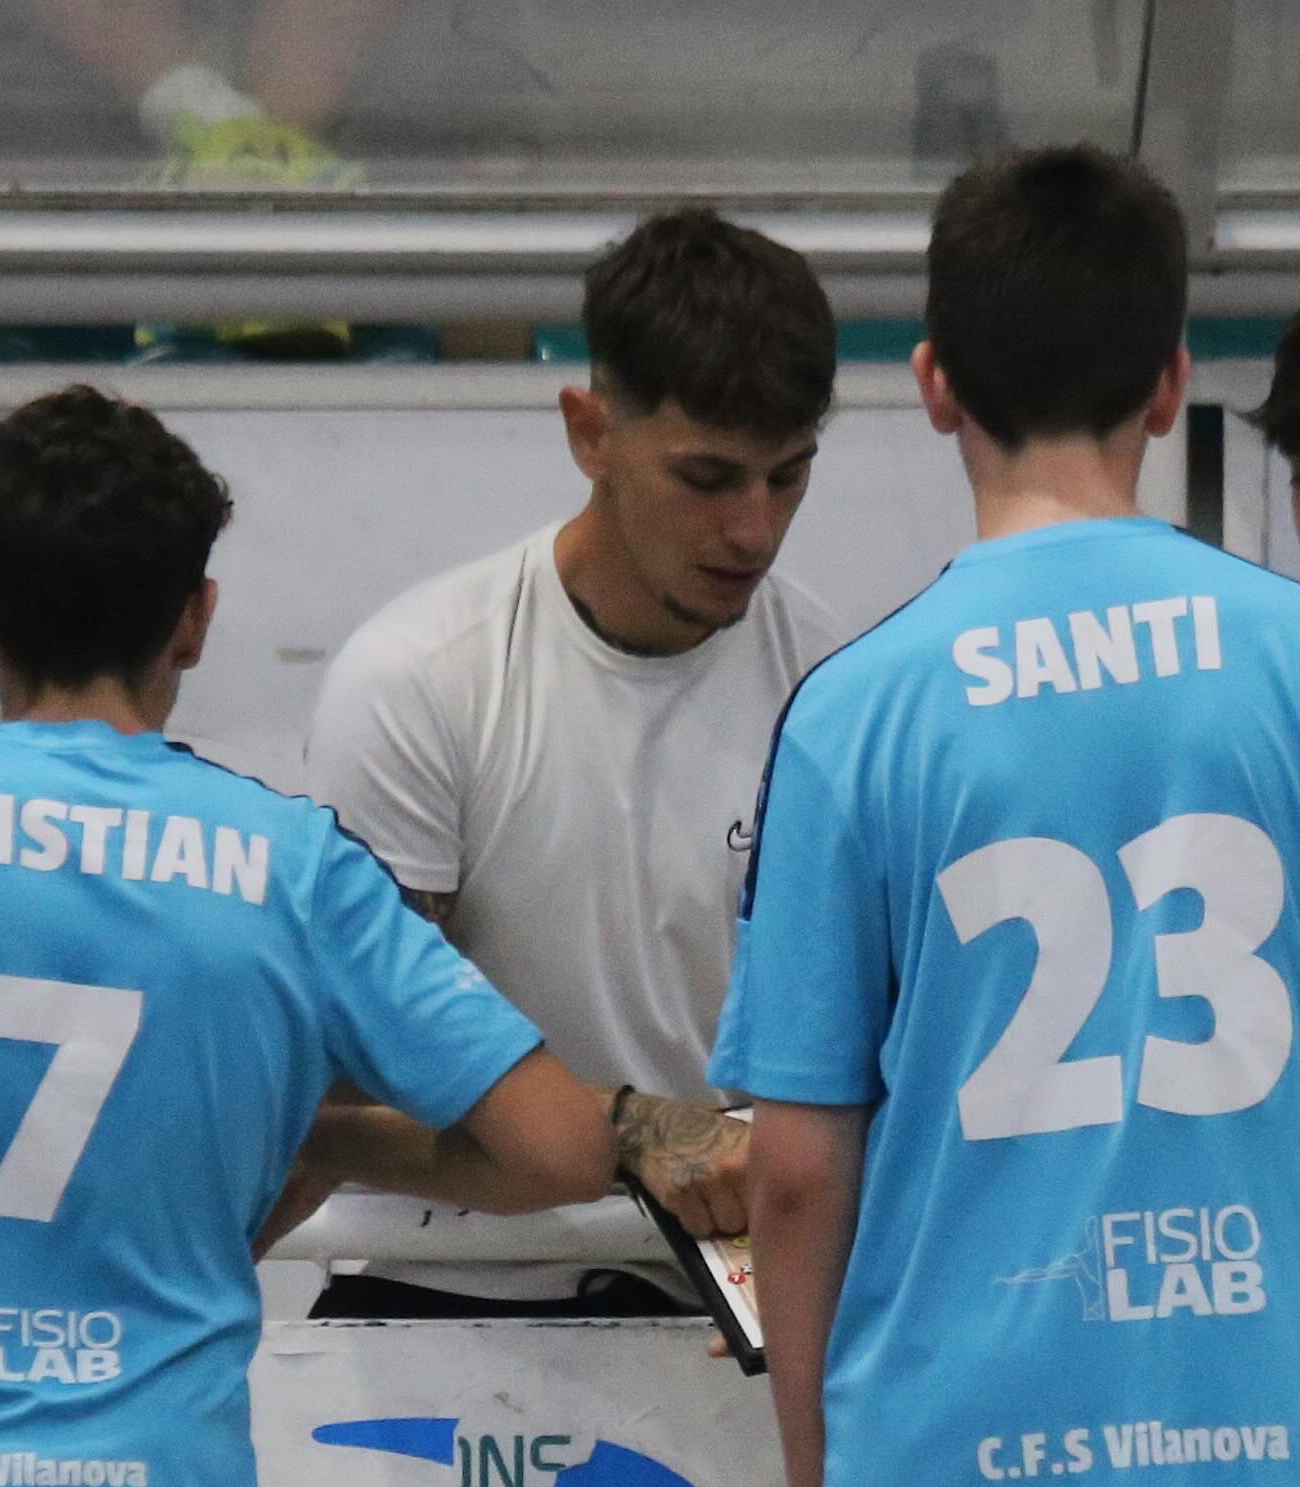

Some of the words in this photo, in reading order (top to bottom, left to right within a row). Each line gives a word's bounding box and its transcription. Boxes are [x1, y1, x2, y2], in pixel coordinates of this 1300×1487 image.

[952, 596, 1222, 707] SANTI
[936, 813, 1293, 1142] 23
[1102, 1204, 1261, 1269] FISIO
[1107, 1261, 1267, 1322] LAB
[977, 1428, 1094, 1480] C.F.S
[1103, 1420, 1291, 1468] Vilanova
